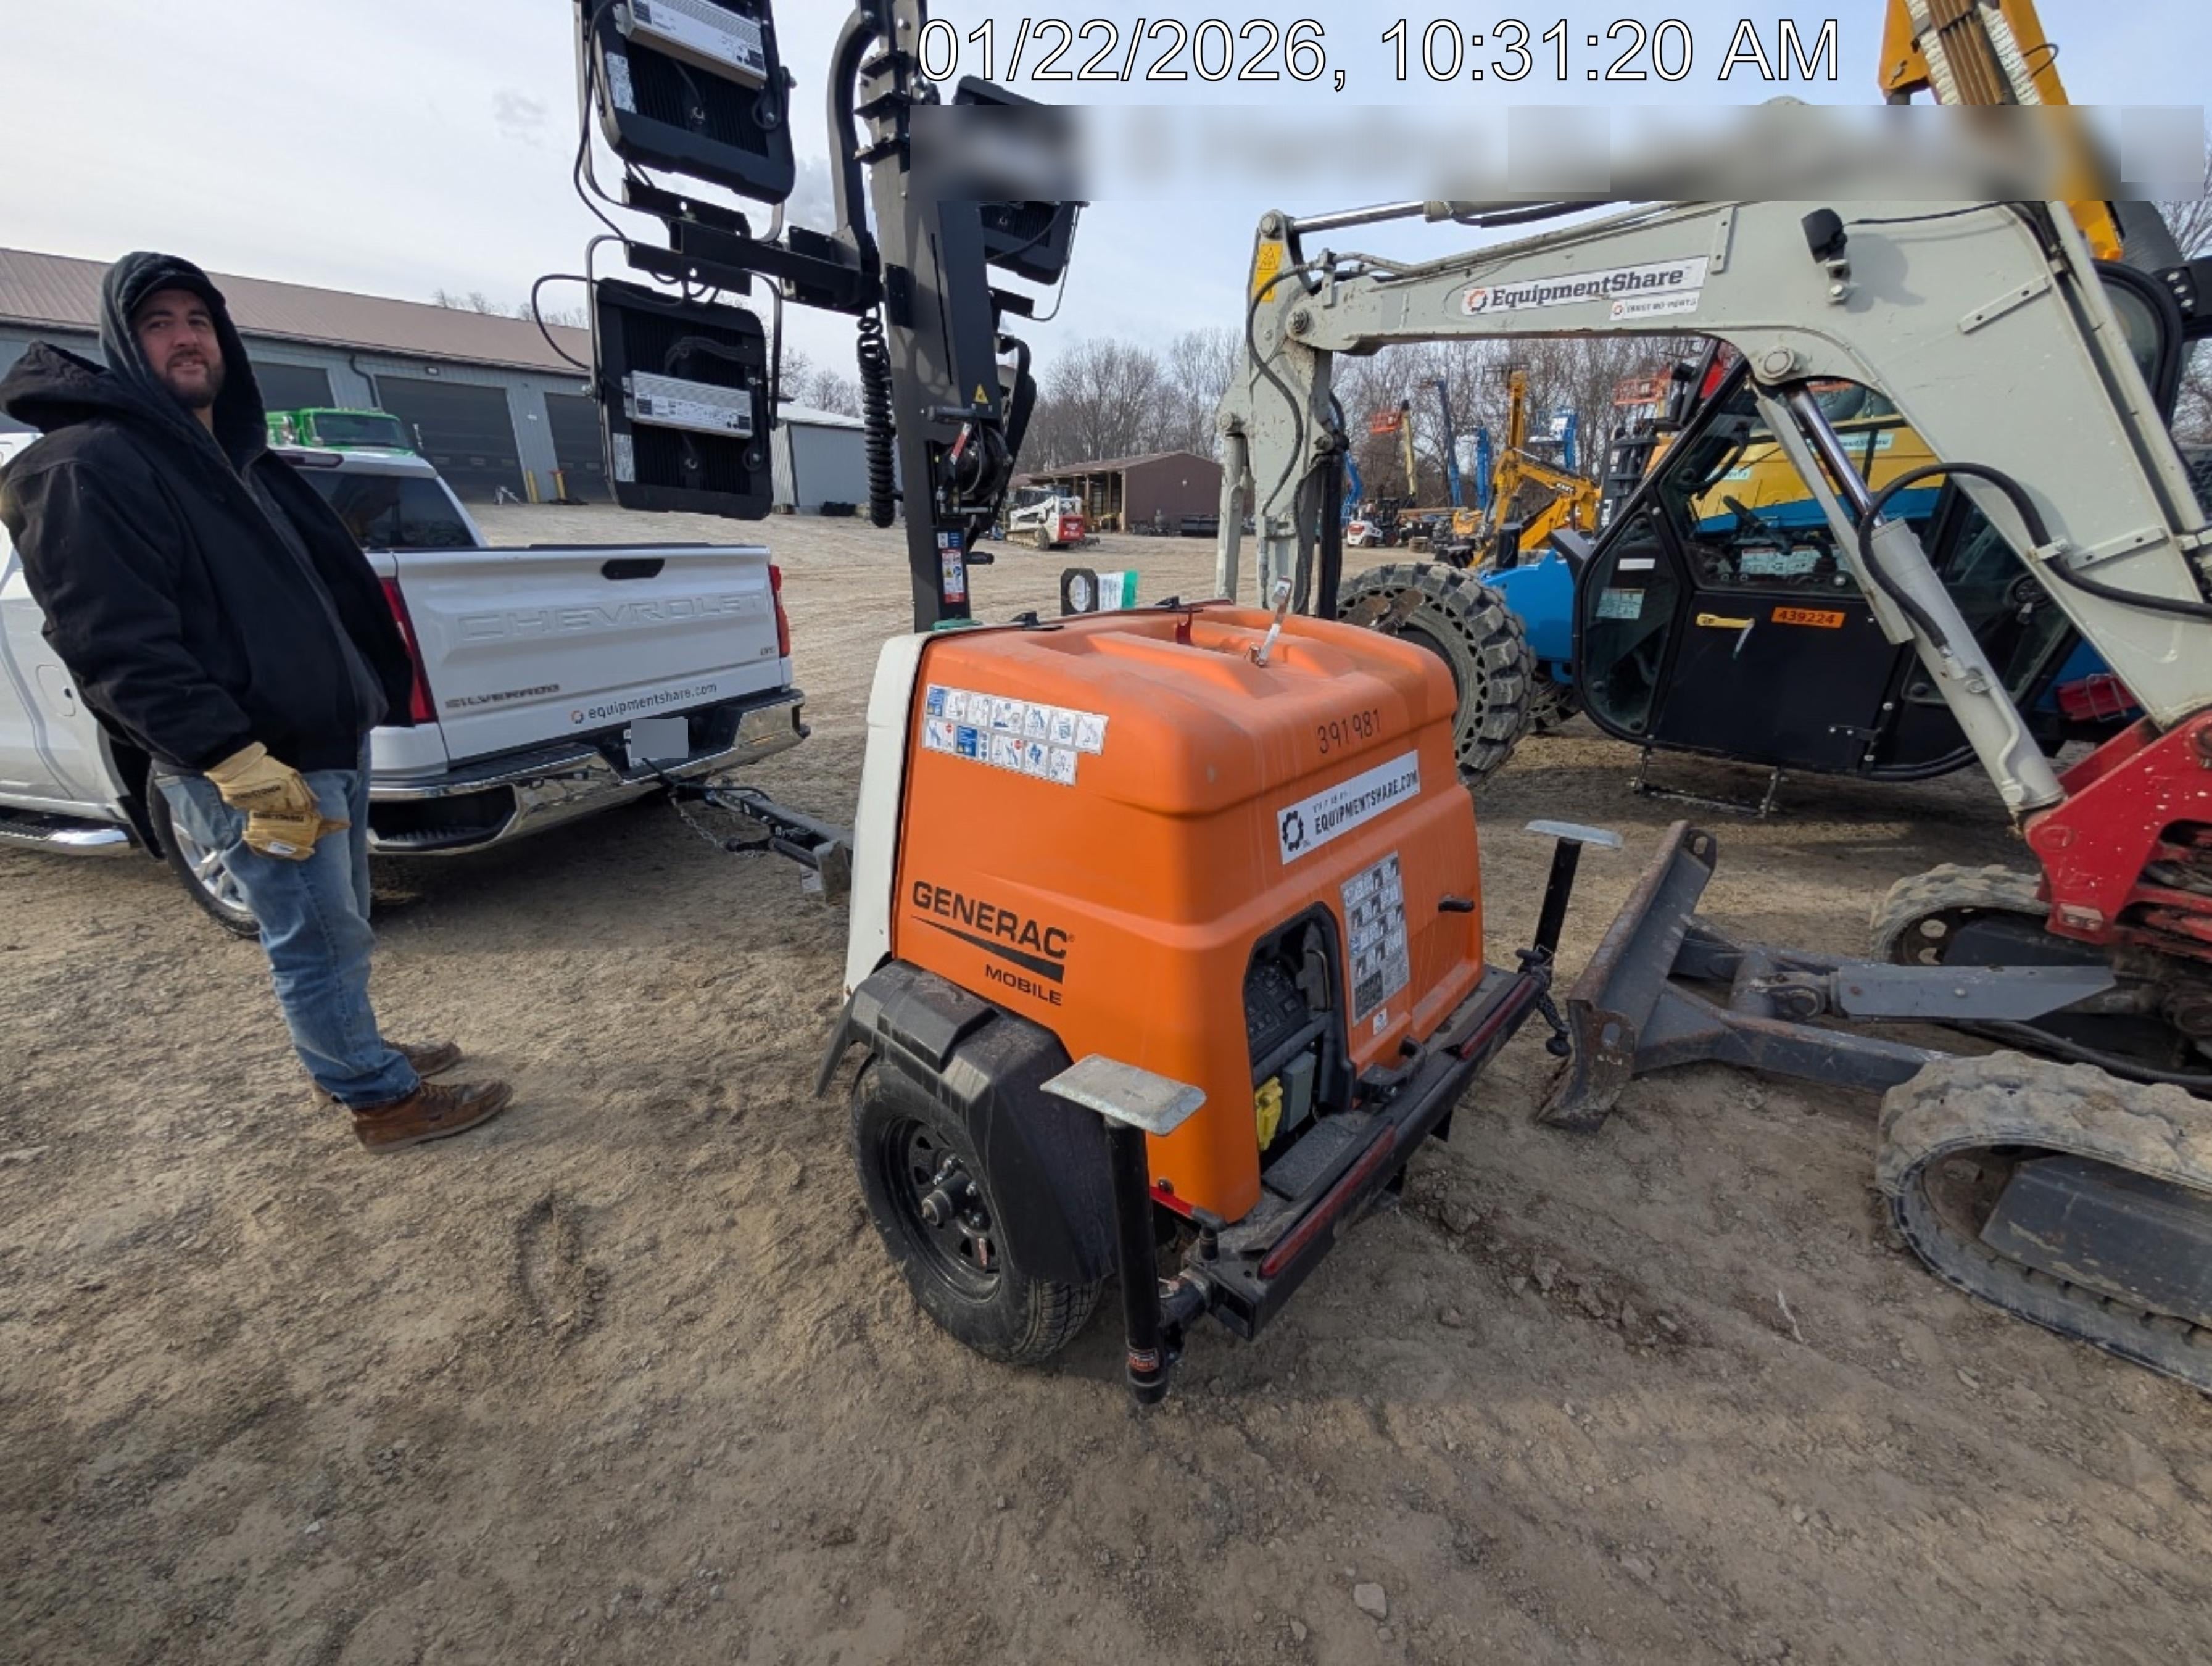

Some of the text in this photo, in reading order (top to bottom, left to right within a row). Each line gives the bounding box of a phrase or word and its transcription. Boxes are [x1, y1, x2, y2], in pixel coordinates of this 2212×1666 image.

[1490, 268, 1684, 309] EquipmentShare
[457, 594, 762, 640] CHEVROLET
[1778, 610, 1836, 624] 439224
[445, 683, 560, 709] SILVERADO
[587, 682, 718, 720] equipmentshare.com
[1318, 709, 1380, 753] 391981
[1315, 770, 1418, 835] EQUIPMENTSHARE.COM
[911, 880, 1067, 960] GENERAC
[985, 963, 1063, 1006] MOBILE
